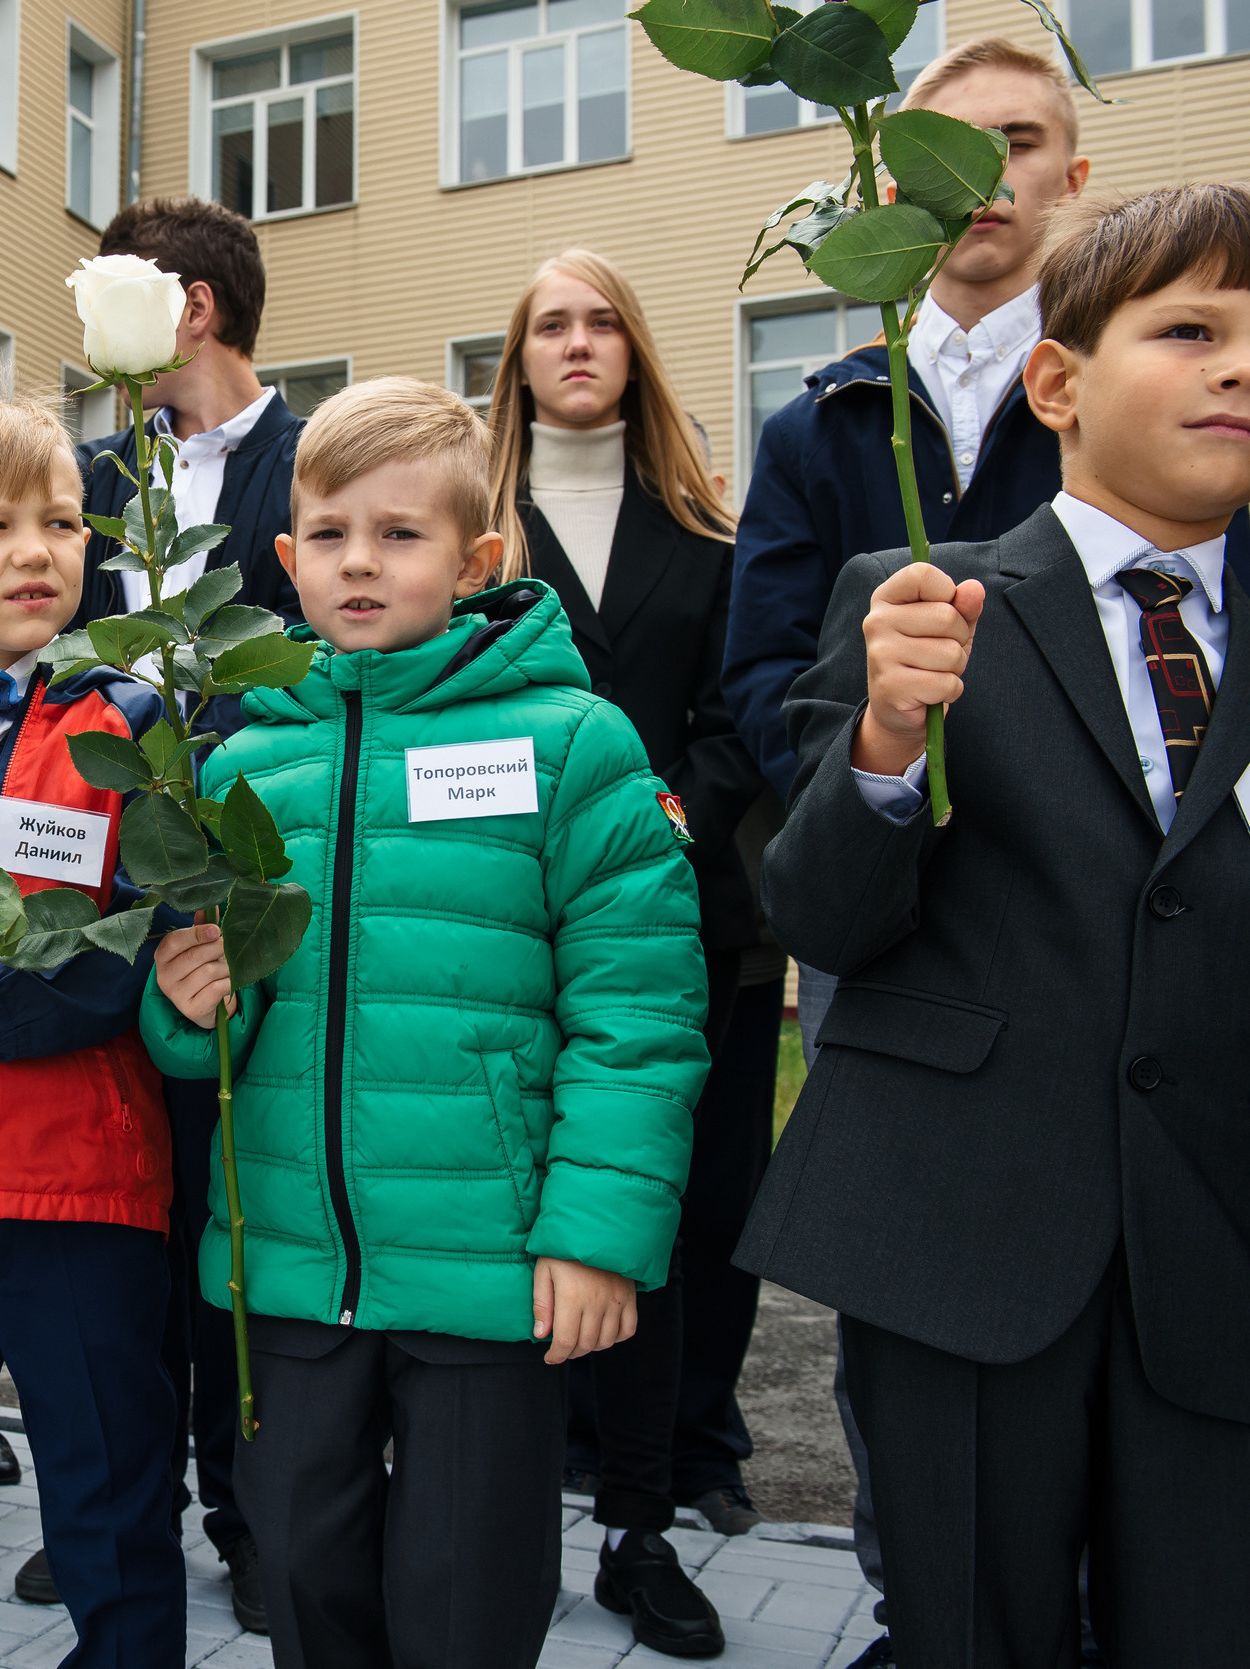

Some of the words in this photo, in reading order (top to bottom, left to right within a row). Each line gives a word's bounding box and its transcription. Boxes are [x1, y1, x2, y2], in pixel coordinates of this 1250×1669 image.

[413, 758, 528, 780] Топоровский
[448, 786, 496, 801] Марк
[19, 816, 87, 839] Жуйков
[15, 841, 82, 864] Даниил
